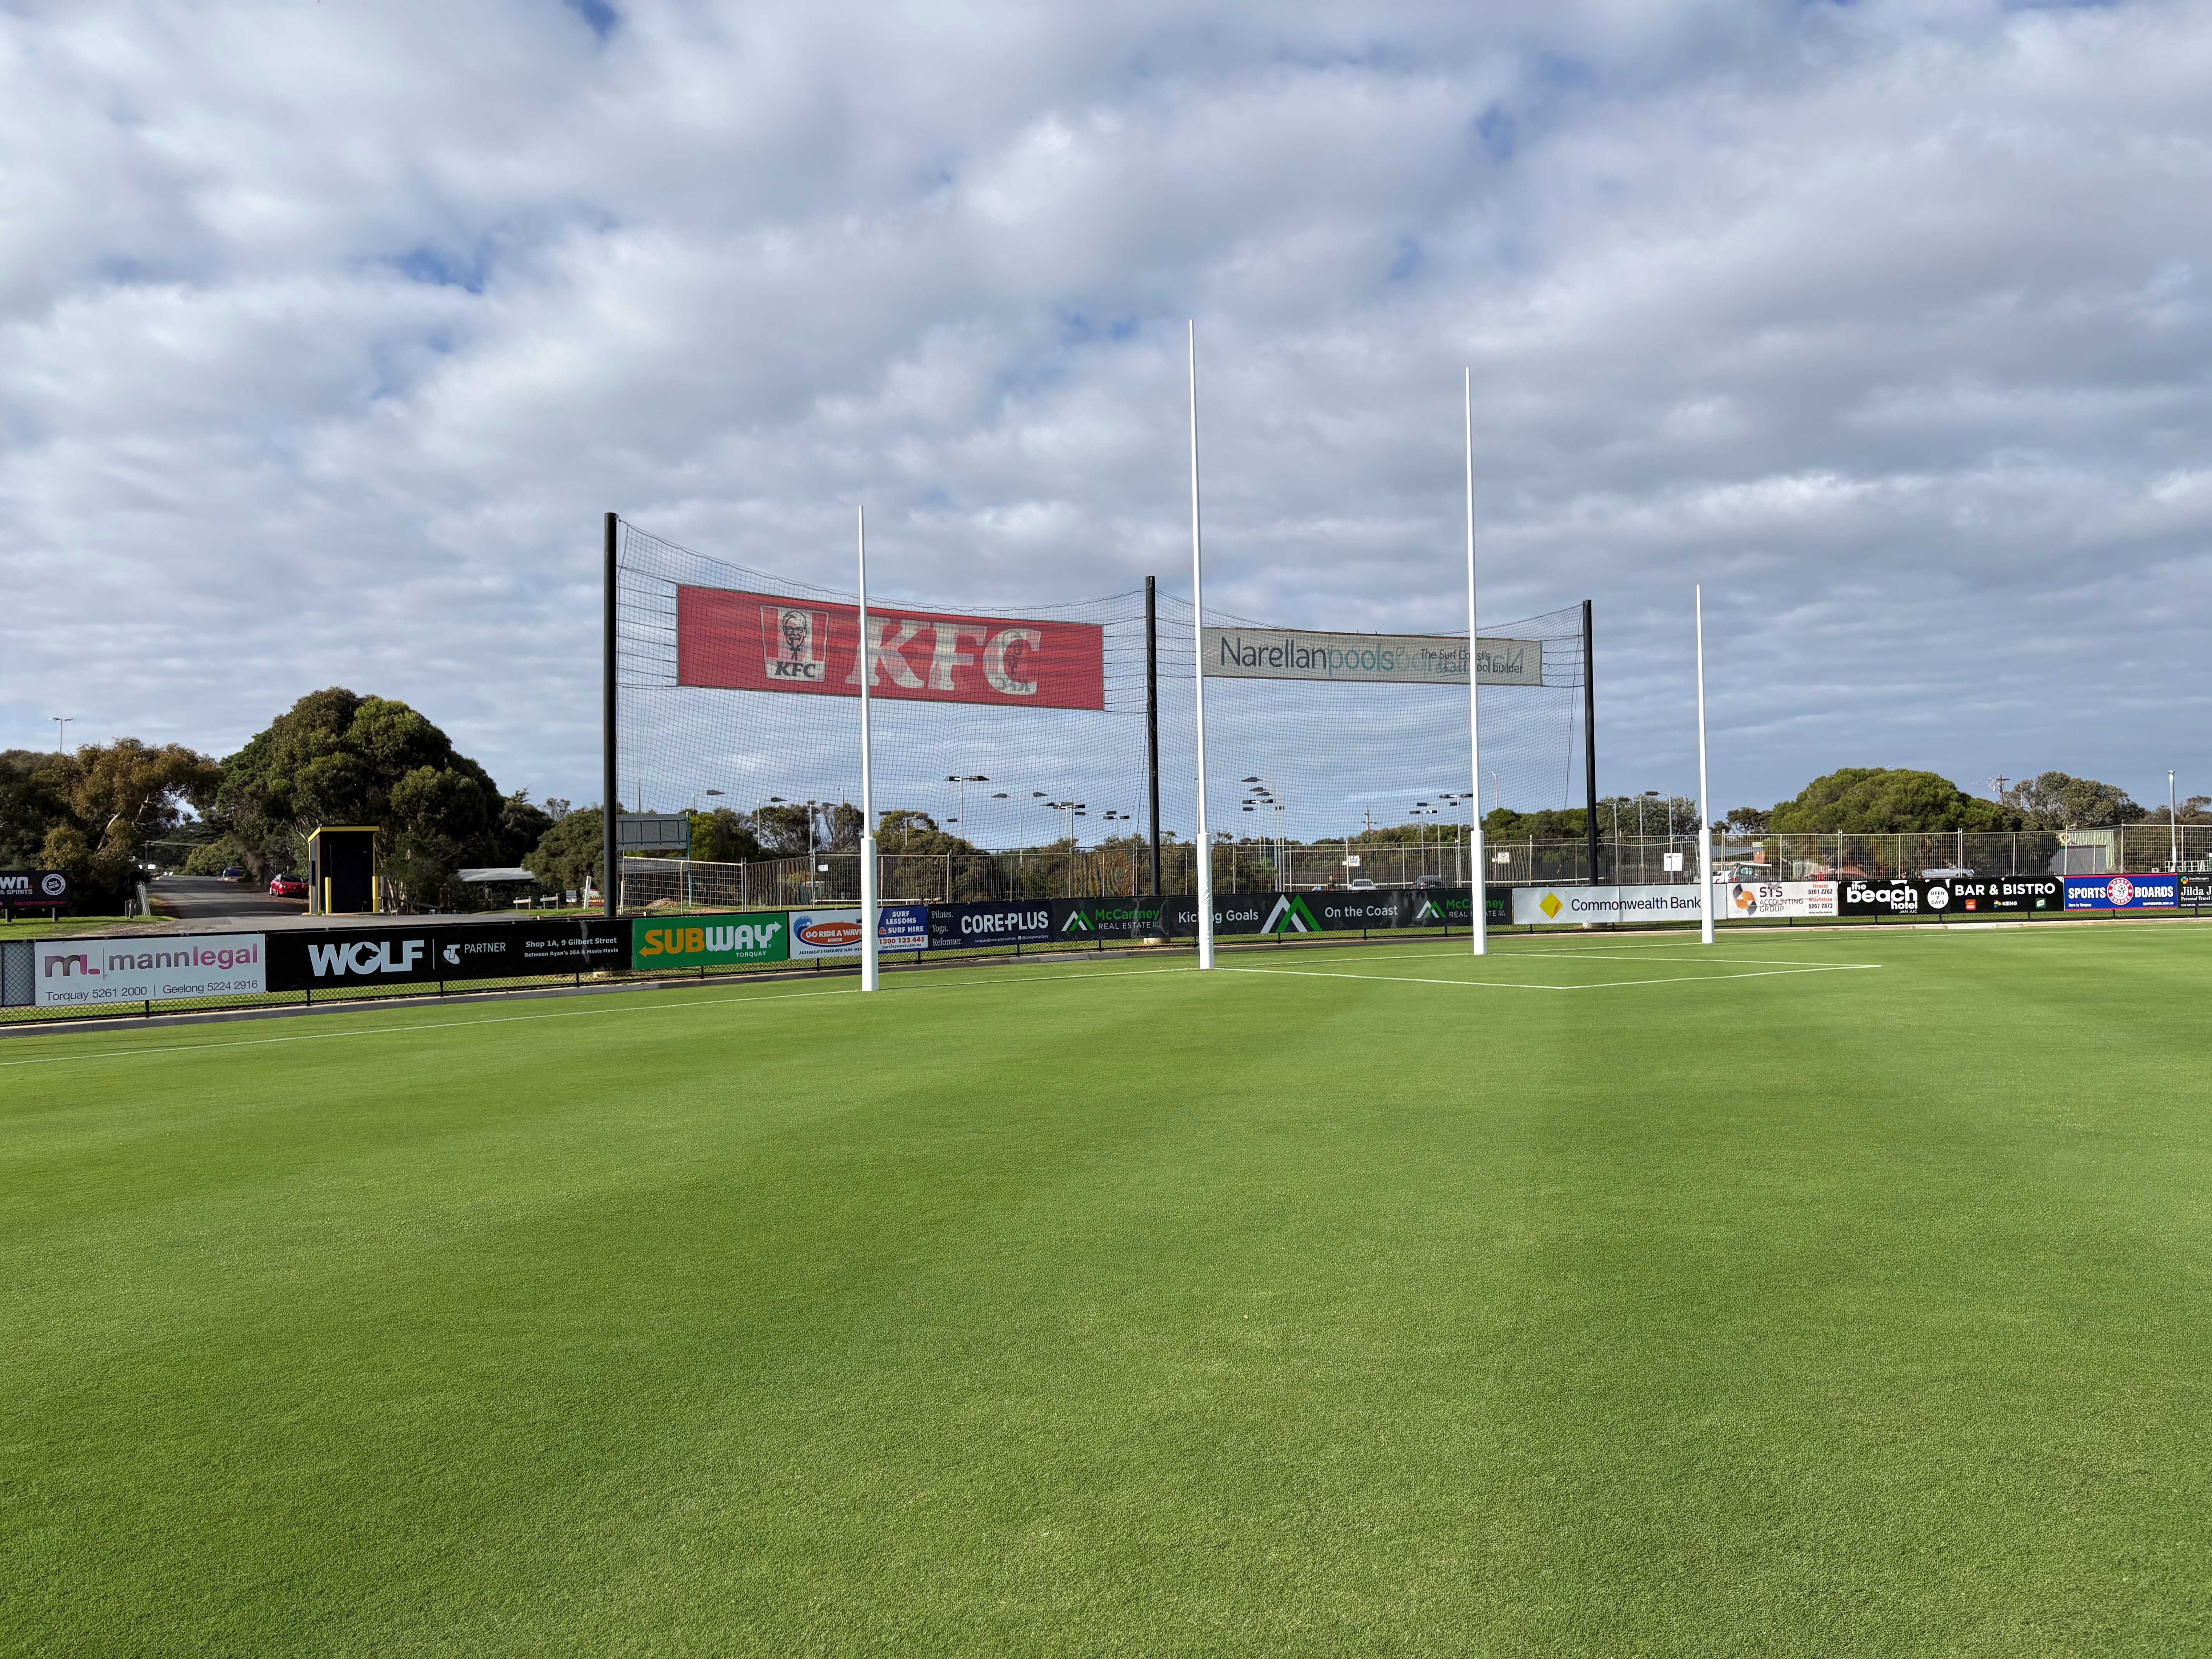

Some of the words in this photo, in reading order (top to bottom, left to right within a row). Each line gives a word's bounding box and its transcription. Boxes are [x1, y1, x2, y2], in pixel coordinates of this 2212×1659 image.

[845, 616, 1042, 696] KFC
[1421, 649, 1436, 659] The
[1439, 649, 1457, 660] Surf
[1458, 650, 1491, 661] Cost's
[775, 661, 816, 678] KFC
[1493, 662, 1523, 674] builder
[2110, 879, 2130, 887] SPORTS
[1760, 886, 1783, 897] STS
[1847, 886, 1918, 903] beach
[1955, 884, 1985, 896] BAR
[1989, 884, 1999, 895] &
[2003, 883, 2056, 895] BISTRO
[2068, 887, 2106, 899] SPORTS
[2135, 886, 2173, 898] BOARDS
[2181, 886, 2204, 896] Jilda
[1446, 898, 1504, 909] McCney
[1571, 896, 1667, 911] Commonwealth
[1671, 896, 1701, 908] Bank
[1891, 900, 1918, 909] hotel
[2110, 895, 2131, 903] BOARDS
[932, 910, 953, 919] Pilates.
[1095, 908, 1159, 921] McCartney
[1178, 911, 1222, 923] Kicg
[1226, 909, 1258, 921] Goals
[1325, 907, 1341, 917] On
[1345, 906, 1362, 917] the
[1366, 905, 1398, 916] Coast
[961, 911, 1049, 934] CORE-PLUS
[932, 924, 948, 934] Yoga.
[639, 921, 782, 957] SUBWAY
[933, 937, 962, 946] Reformer.
[464, 942, 506, 953] PARTNER
[109, 943, 257, 970] mannlegal
[308, 940, 424, 976] WOLF
[163, 984, 204, 994] Geelong
[208, 982, 231, 991] 5224
[234, 980, 258, 989] 2916
[45, 992, 89, 1002] Torquay
[93, 988, 116, 998] 5261
[122, 987, 147, 996] 2000
